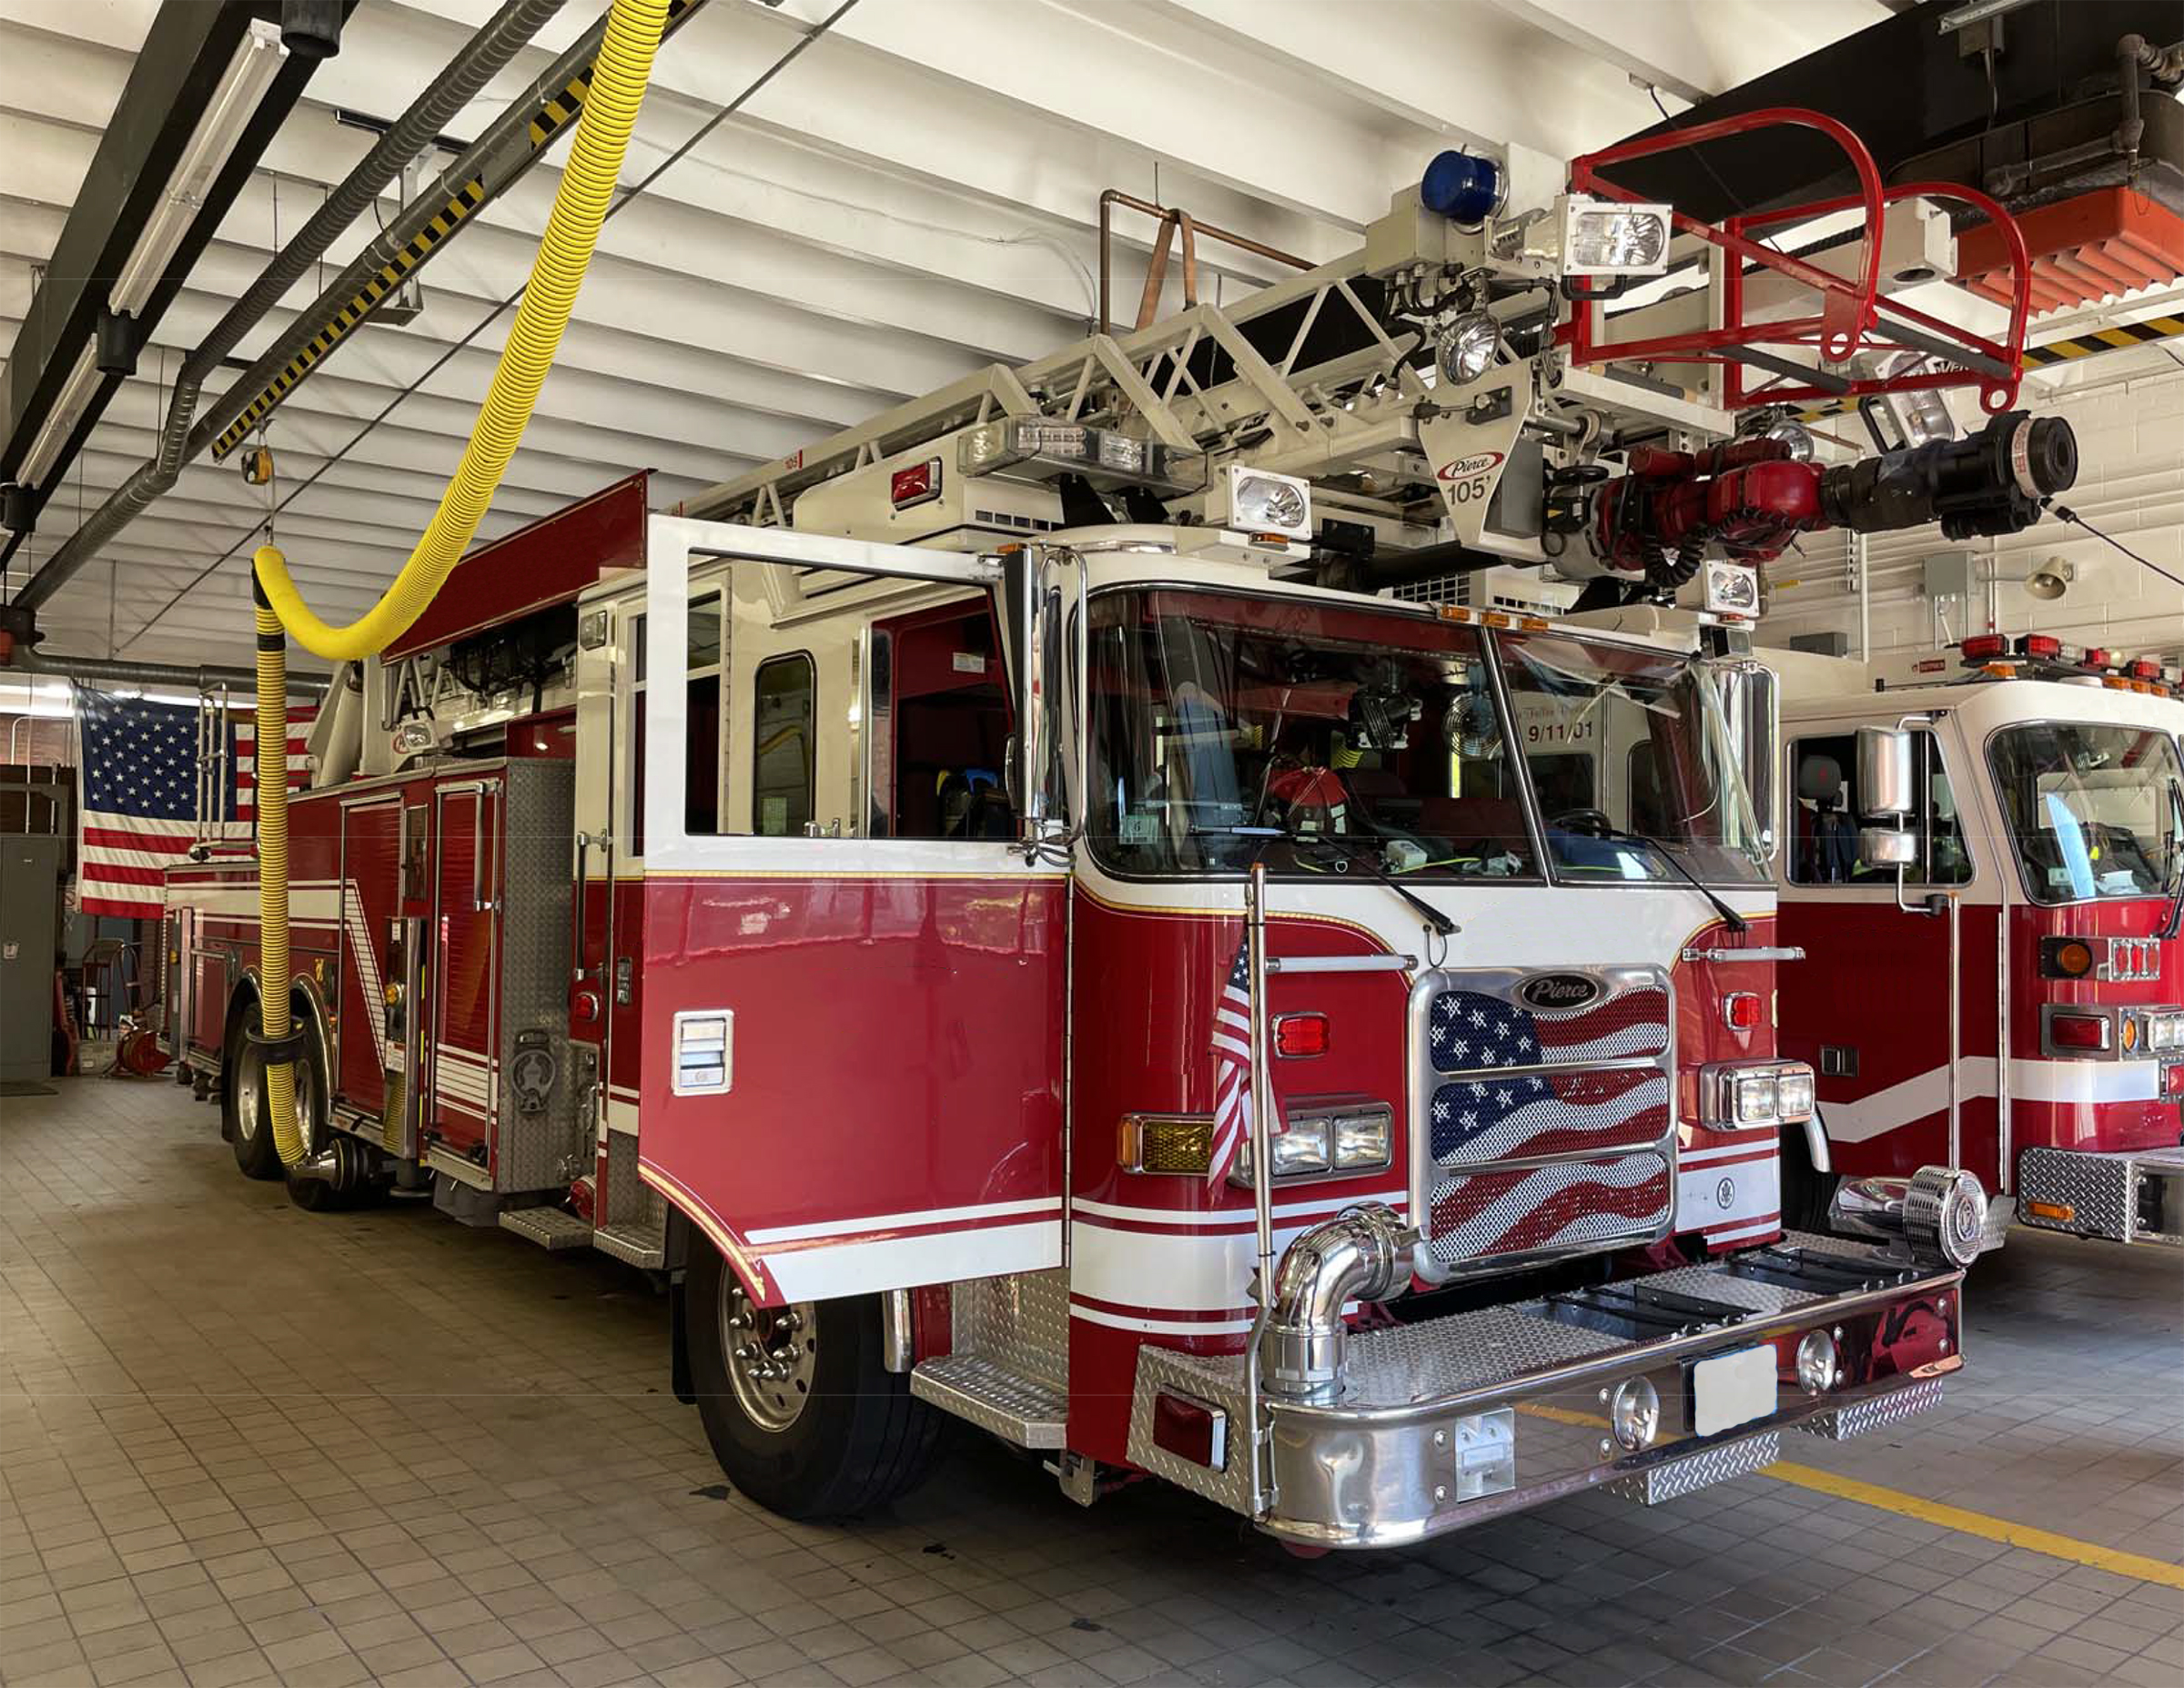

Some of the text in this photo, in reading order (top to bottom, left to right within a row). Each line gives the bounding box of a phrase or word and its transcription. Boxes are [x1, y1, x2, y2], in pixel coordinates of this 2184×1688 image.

[1451, 458, 1489, 478] Pierce
[1448, 475, 1491, 505] 105'
[1529, 721, 1592, 743] 9/11/01
[1532, 978, 1589, 1002] Pierce
